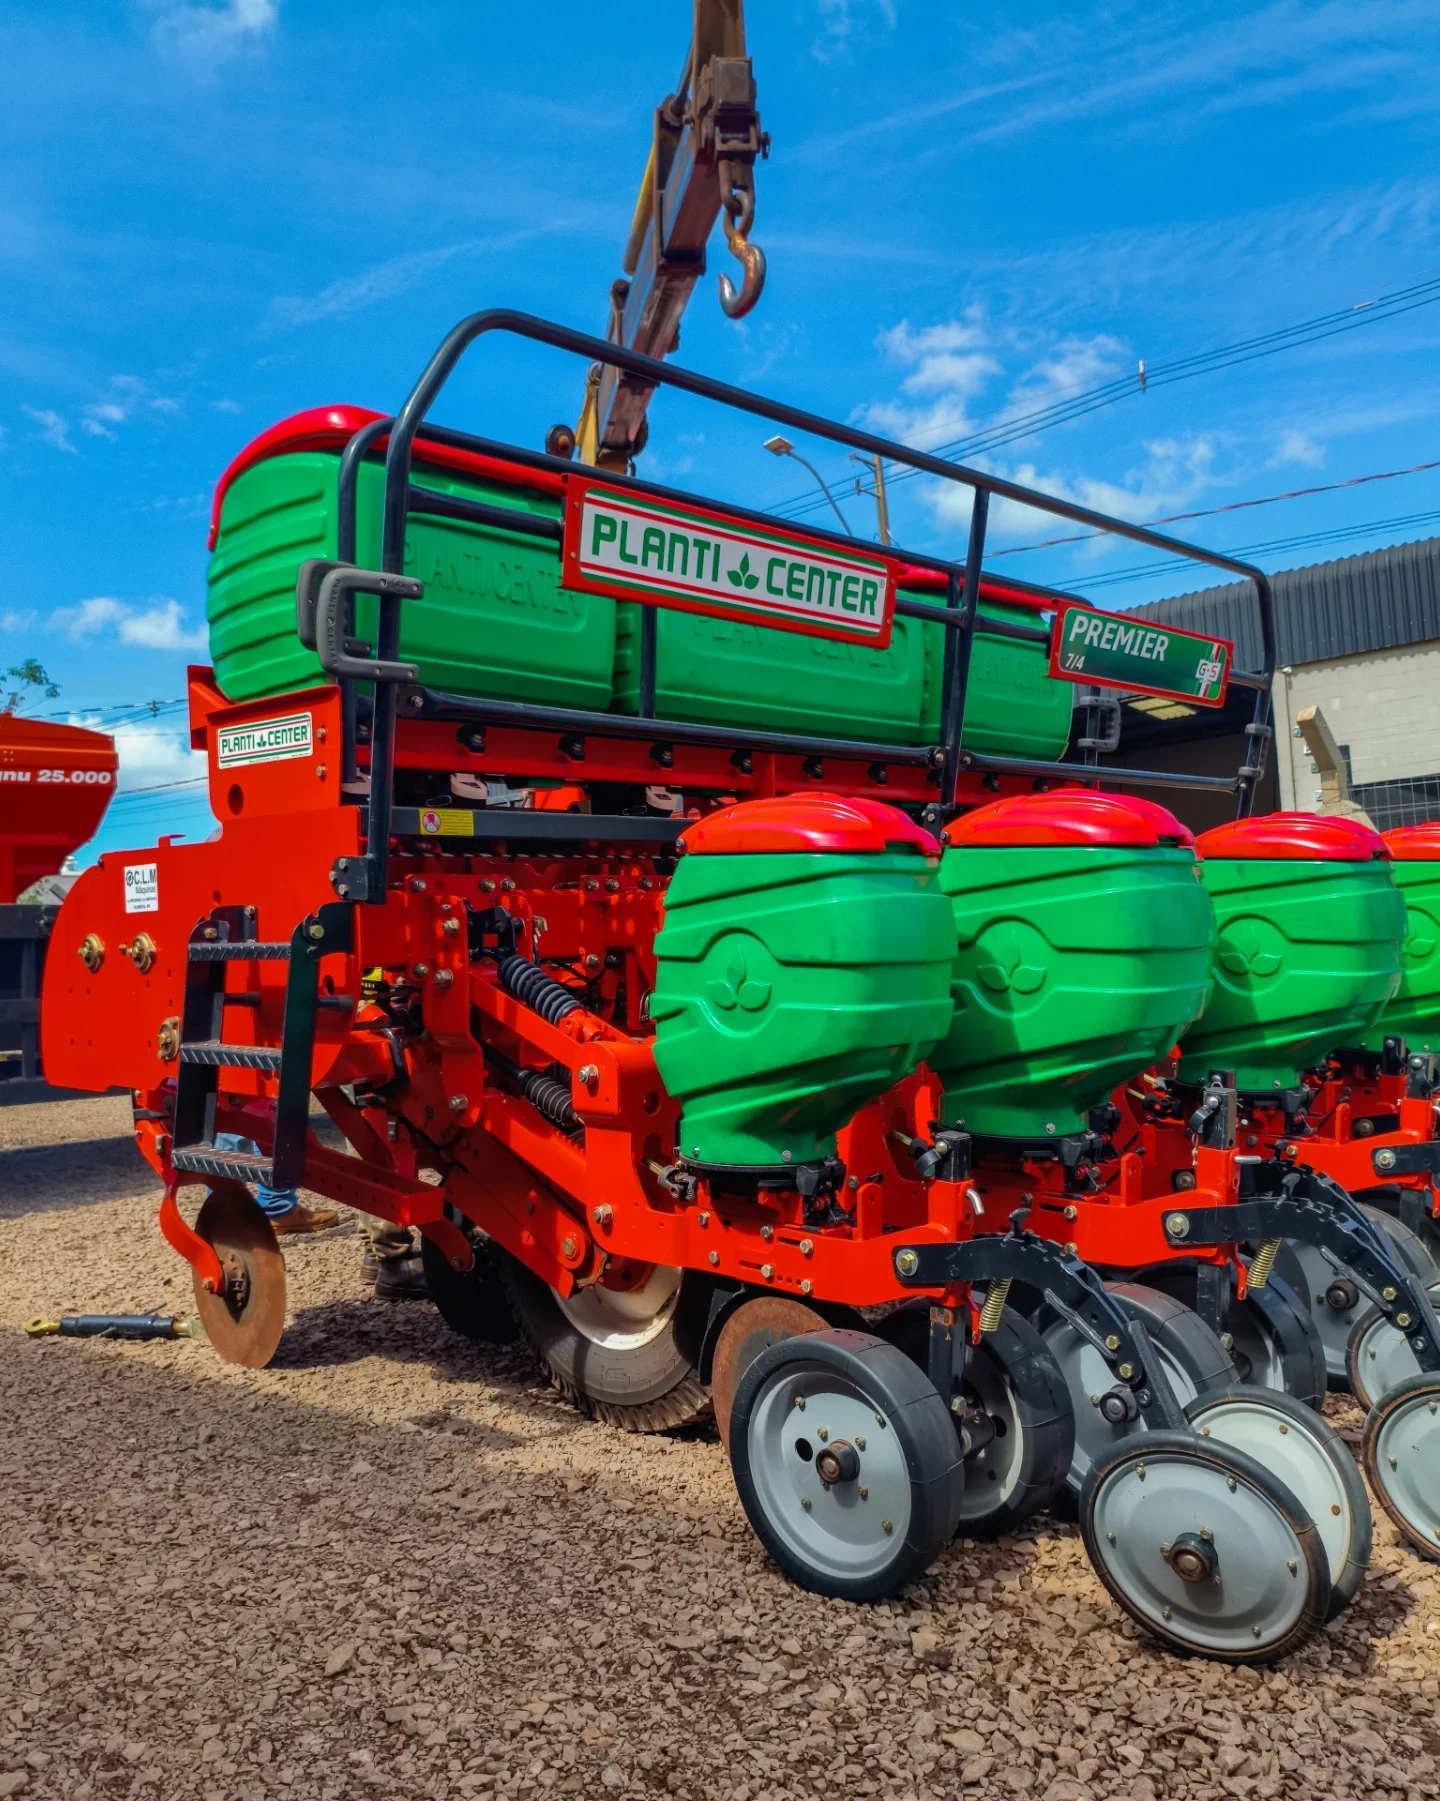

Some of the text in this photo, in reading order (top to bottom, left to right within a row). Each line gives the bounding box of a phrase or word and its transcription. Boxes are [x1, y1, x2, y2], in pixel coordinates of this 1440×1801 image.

[591, 513, 721, 583] PLANTI
[1068, 614, 1169, 662] PREMIER
[1064, 652, 1085, 671] 7/4
[221, 734, 255, 754] PLANTI
[0, 768, 112, 784] nu 25.000
